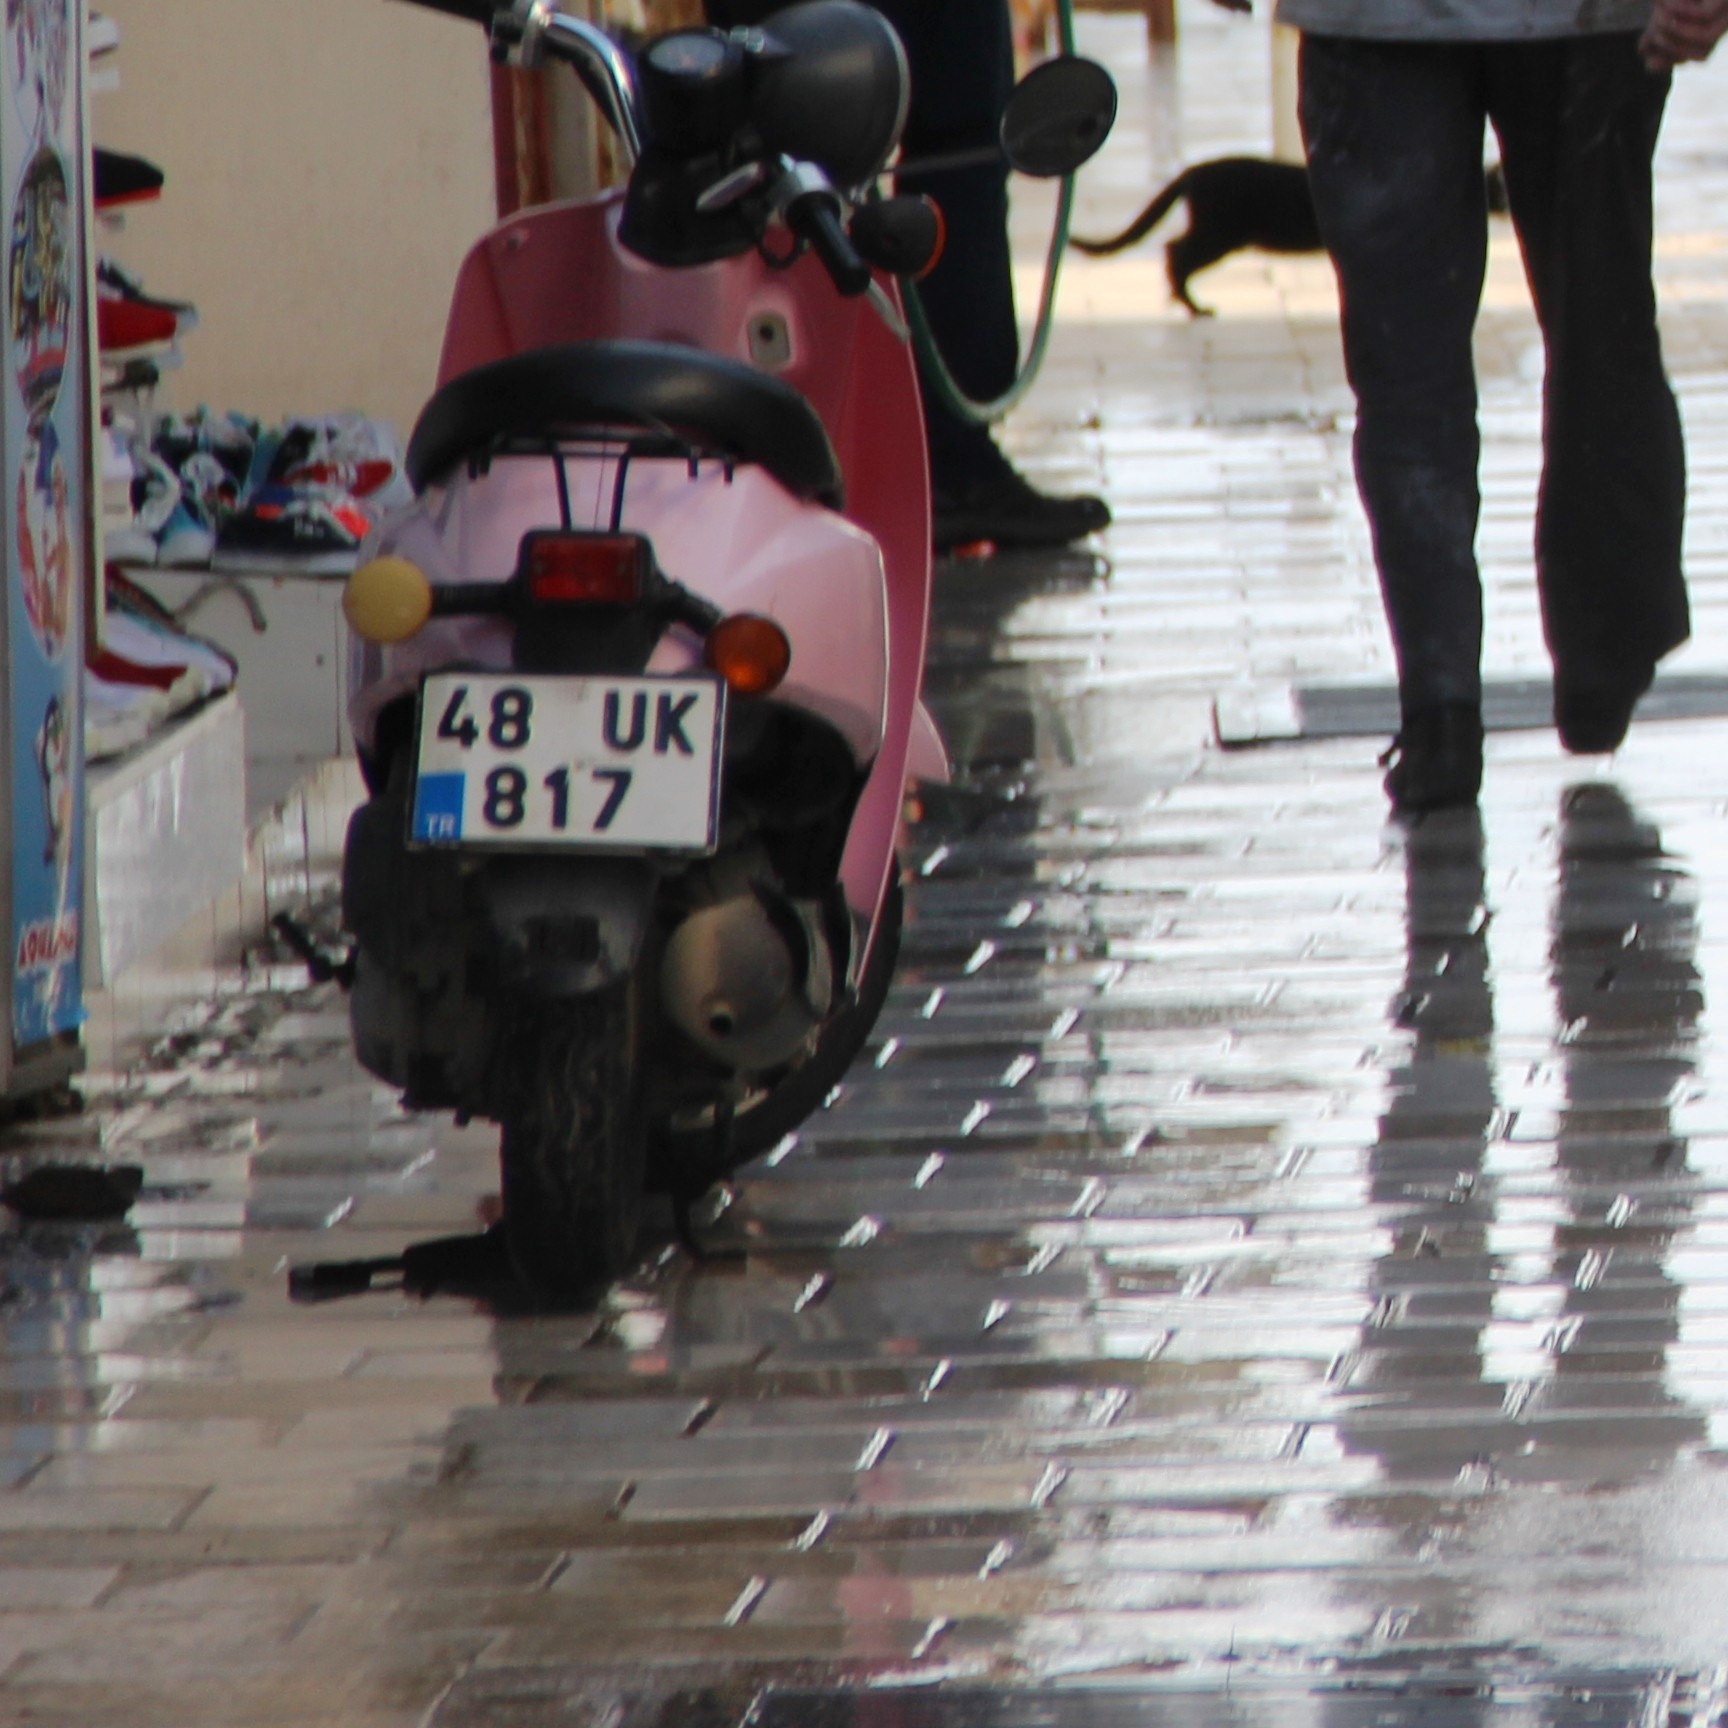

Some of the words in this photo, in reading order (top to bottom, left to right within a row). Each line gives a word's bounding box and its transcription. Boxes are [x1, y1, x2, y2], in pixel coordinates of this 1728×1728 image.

[437, 685, 533, 752] 48
[602, 688, 700, 756] UK
[483, 765, 633, 832] 817
